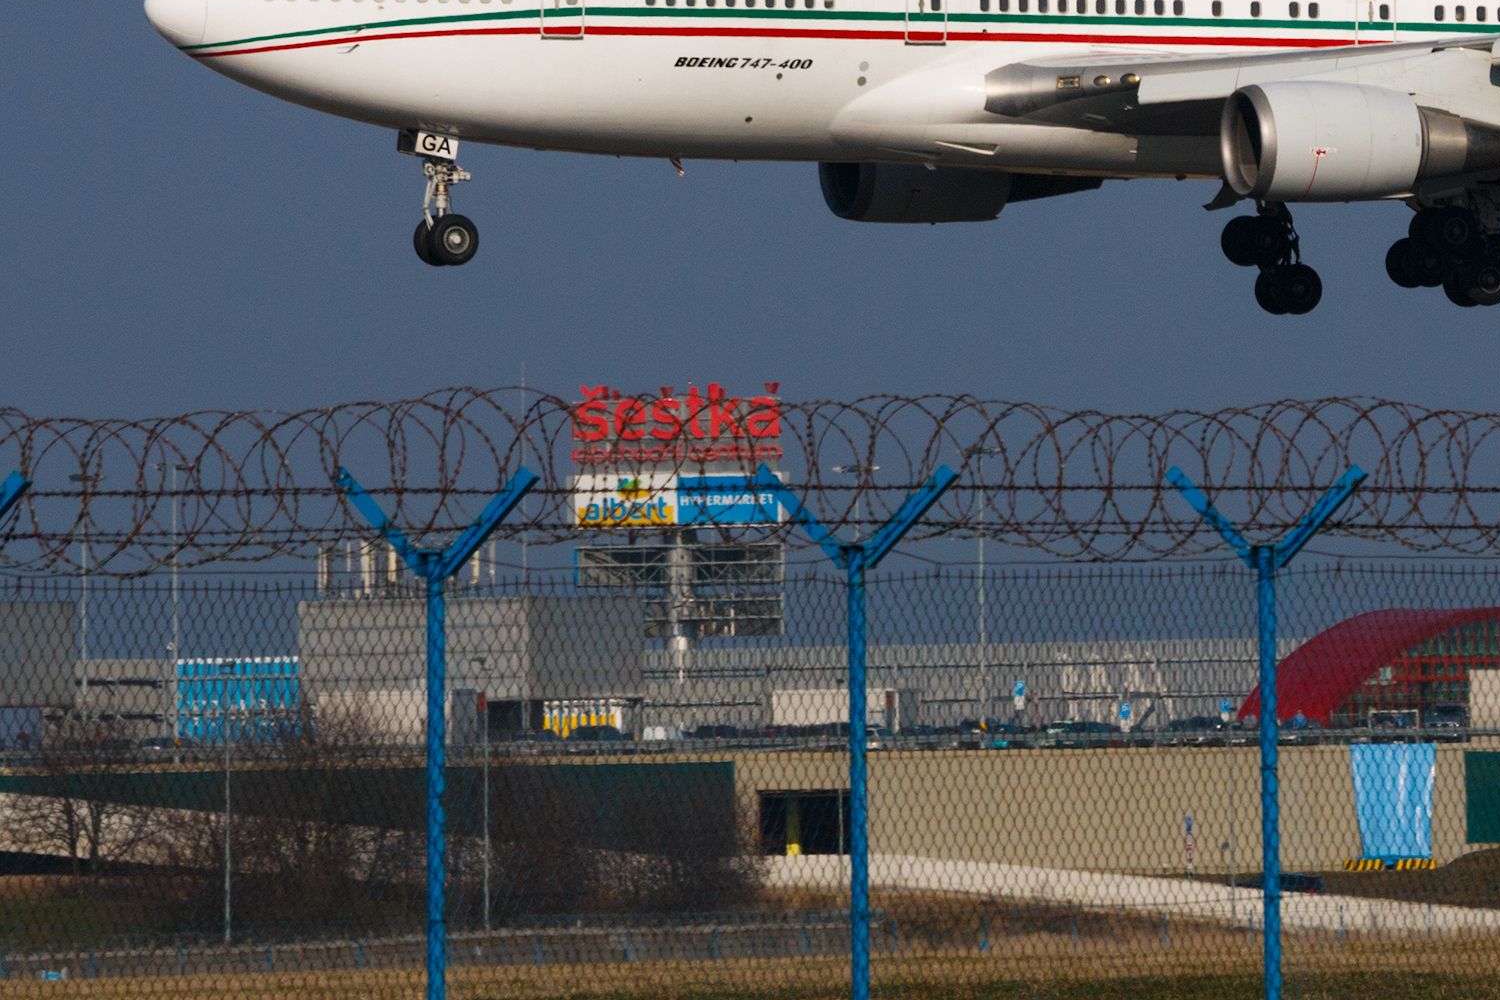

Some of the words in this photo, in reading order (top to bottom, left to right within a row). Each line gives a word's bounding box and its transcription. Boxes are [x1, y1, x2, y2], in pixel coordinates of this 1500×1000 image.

[674, 56, 739, 69] BOEING
[740, 58, 813, 70] 747-400
[422, 134, 451, 154] GA
[585, 496, 668, 521] albert
